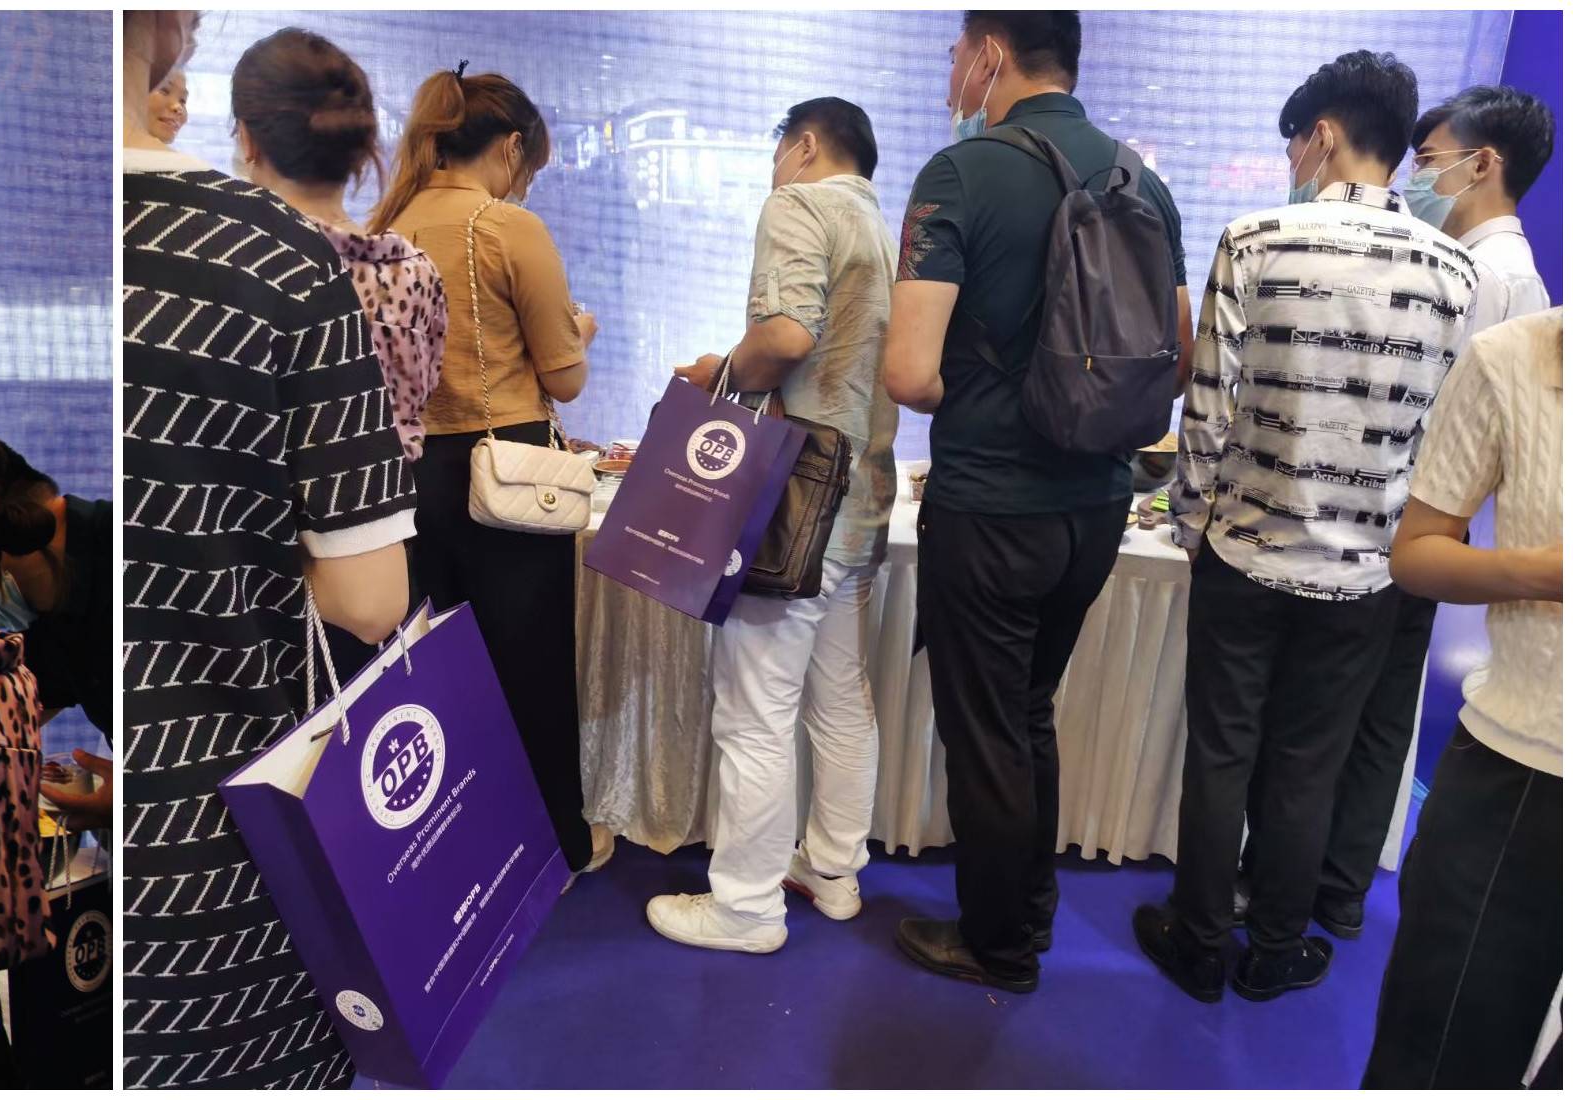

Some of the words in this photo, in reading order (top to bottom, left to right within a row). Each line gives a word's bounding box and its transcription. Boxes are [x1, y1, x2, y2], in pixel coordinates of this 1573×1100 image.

[1347, 284, 1377, 297] GAZETTE
[1340, 339, 1380, 355] Herald
[1384, 342, 1423, 360] Tribune
[700, 440, 734, 461] OPB
[664, 468, 688, 482] Overseas
[688, 478, 714, 493] Prominent
[713, 488, 731, 500] Brands
[1311, 470, 1350, 485] Herald
[1293, 587, 1332, 601] Herald
[381, 732, 429, 798] OPB
[387, 840, 418, 884] Overseas
[416, 795, 453, 842] Prominent
[451, 768, 477, 798] Brands
